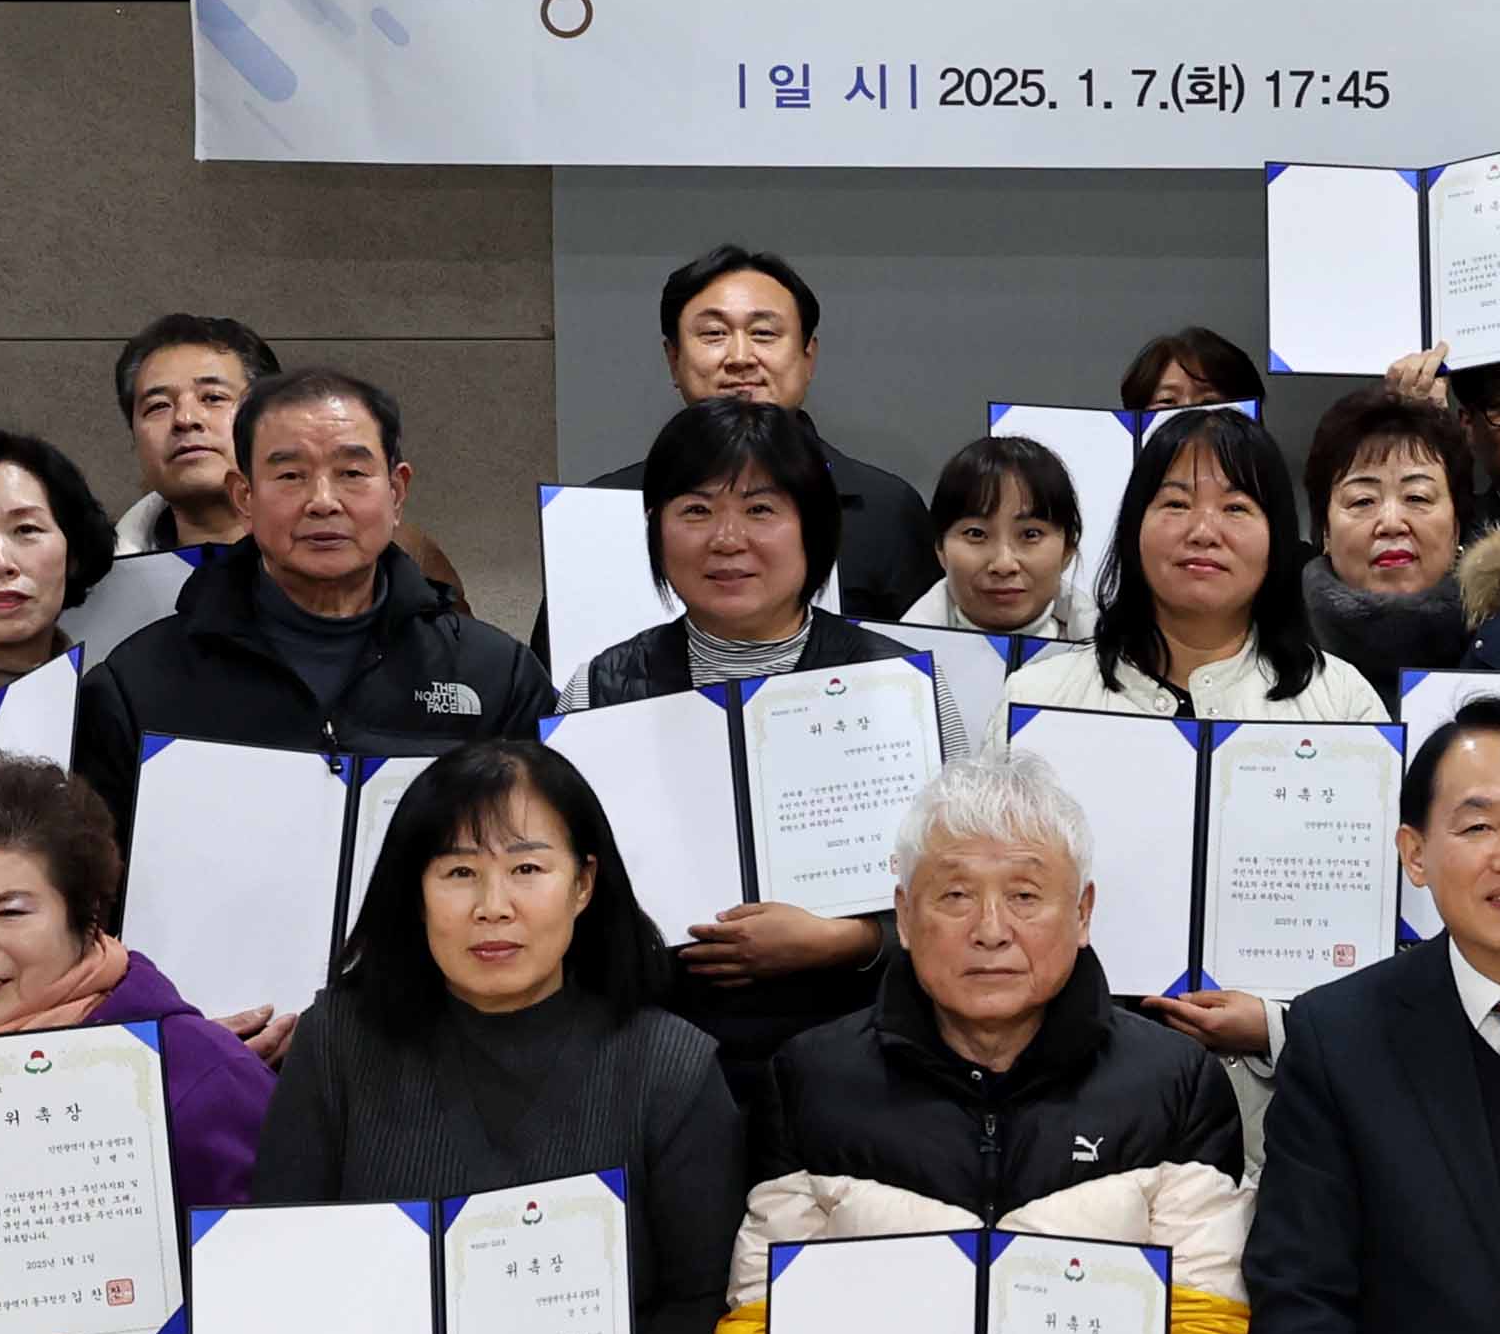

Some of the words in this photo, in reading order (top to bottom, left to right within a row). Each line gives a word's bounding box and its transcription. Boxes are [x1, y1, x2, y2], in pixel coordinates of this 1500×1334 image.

[938, 67, 1058, 110] 2025.
[1078, 68, 1114, 110] 1.
[1131, 62, 1246, 114] 7.(화)
[1265, 69, 1390, 110] 17:45
[431, 681, 458, 694] THE
[414, 689, 458, 704] NORTH
[426, 700, 460, 714] FACE
